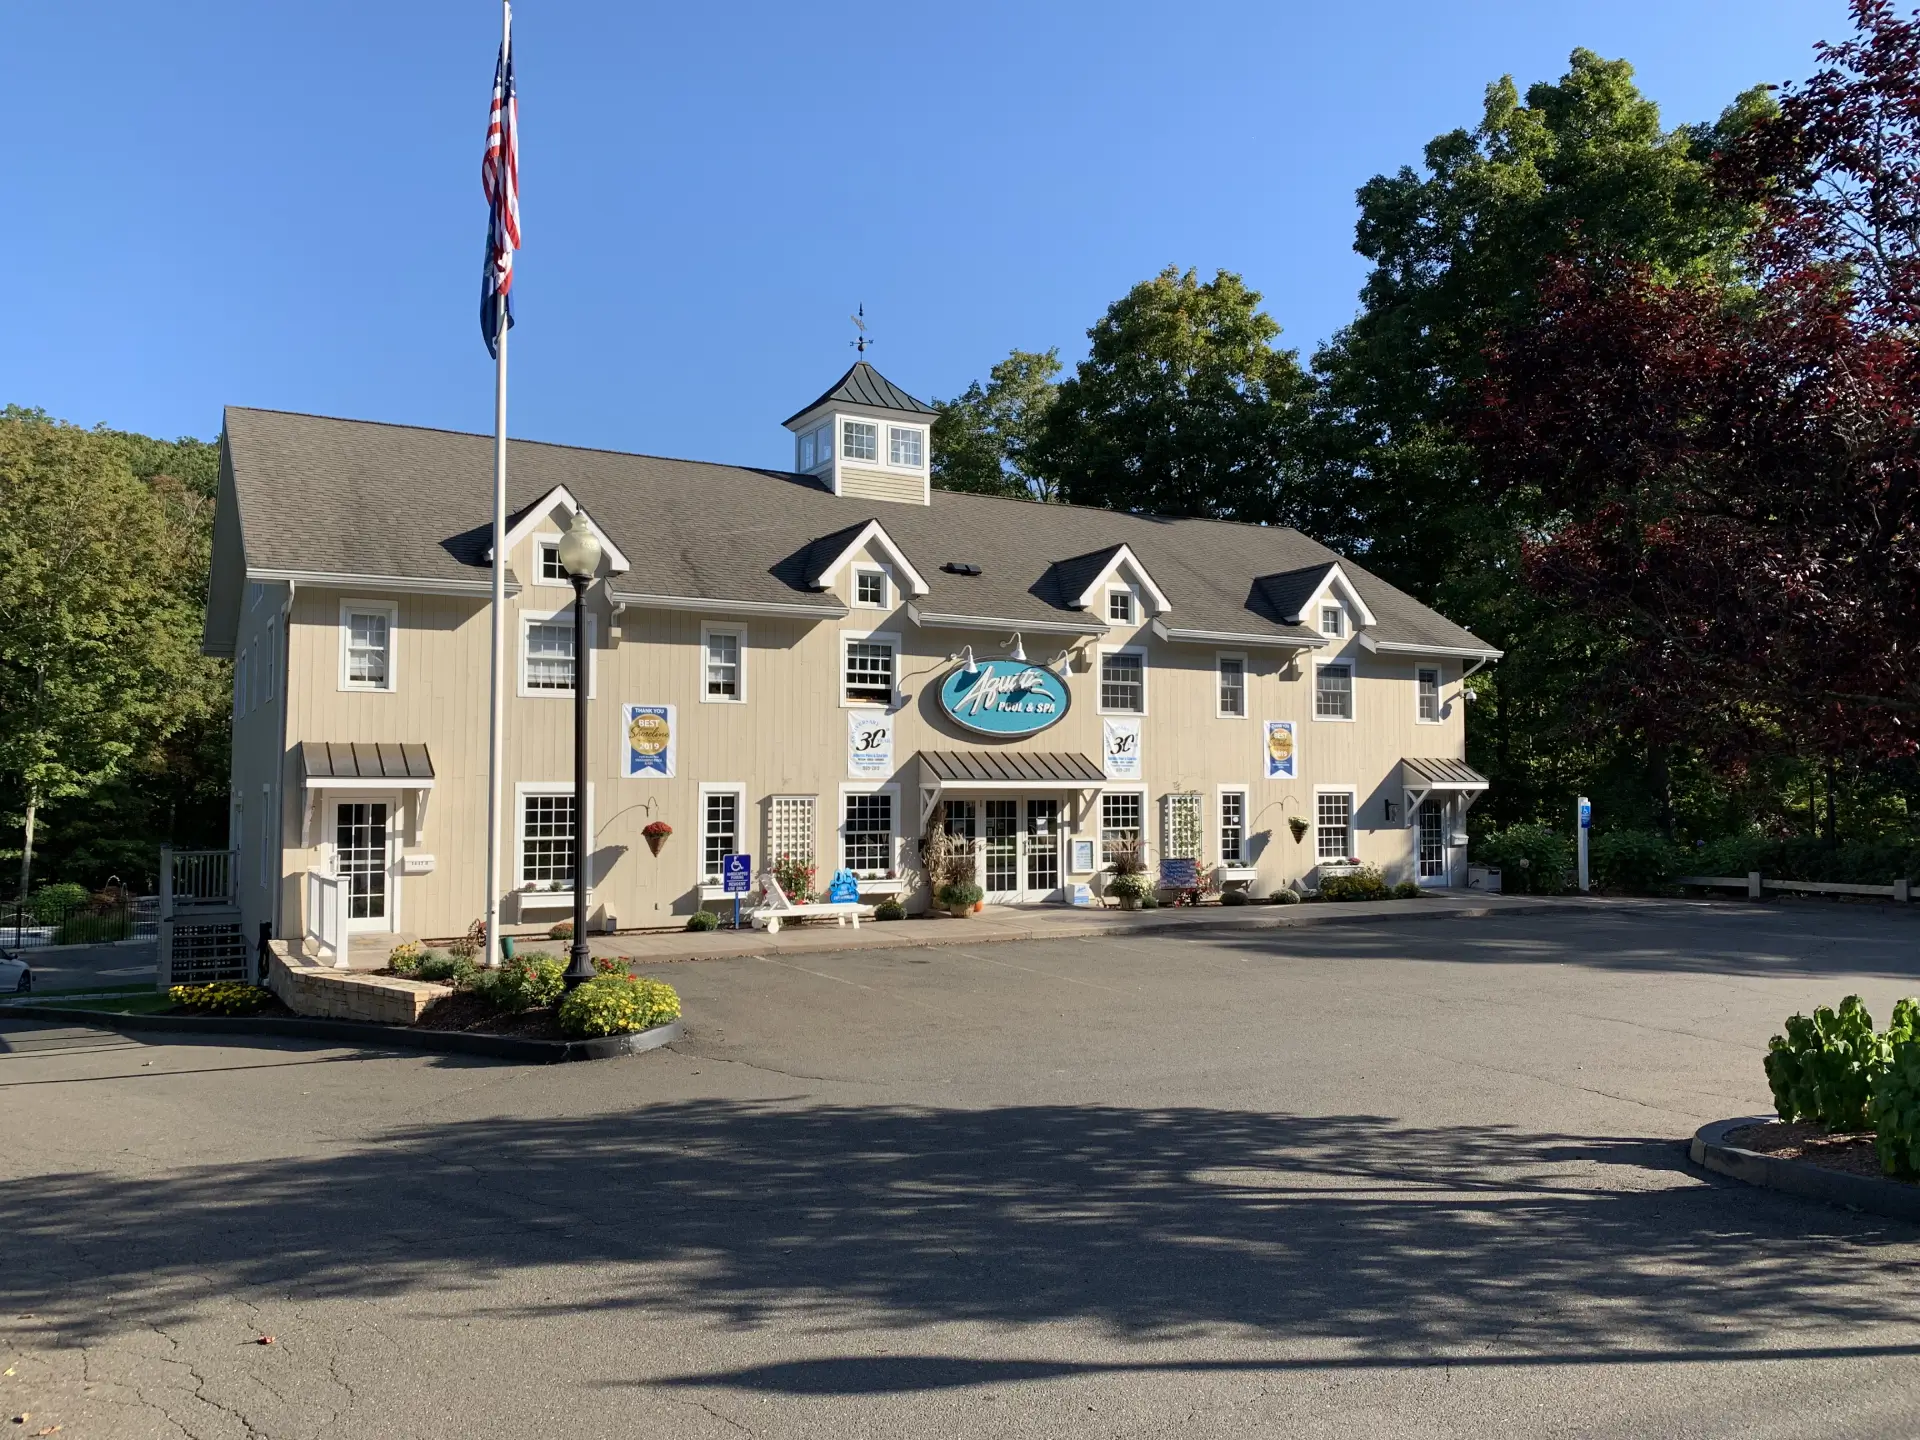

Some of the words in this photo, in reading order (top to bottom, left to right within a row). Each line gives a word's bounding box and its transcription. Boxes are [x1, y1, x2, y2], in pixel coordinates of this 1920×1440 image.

[998, 702, 1023, 713] POOL
[1025, 703, 1035, 713] &
[1036, 703, 1056, 713] SPA
[638, 719, 660, 727] BEST
[639, 742, 660, 750] 2019
